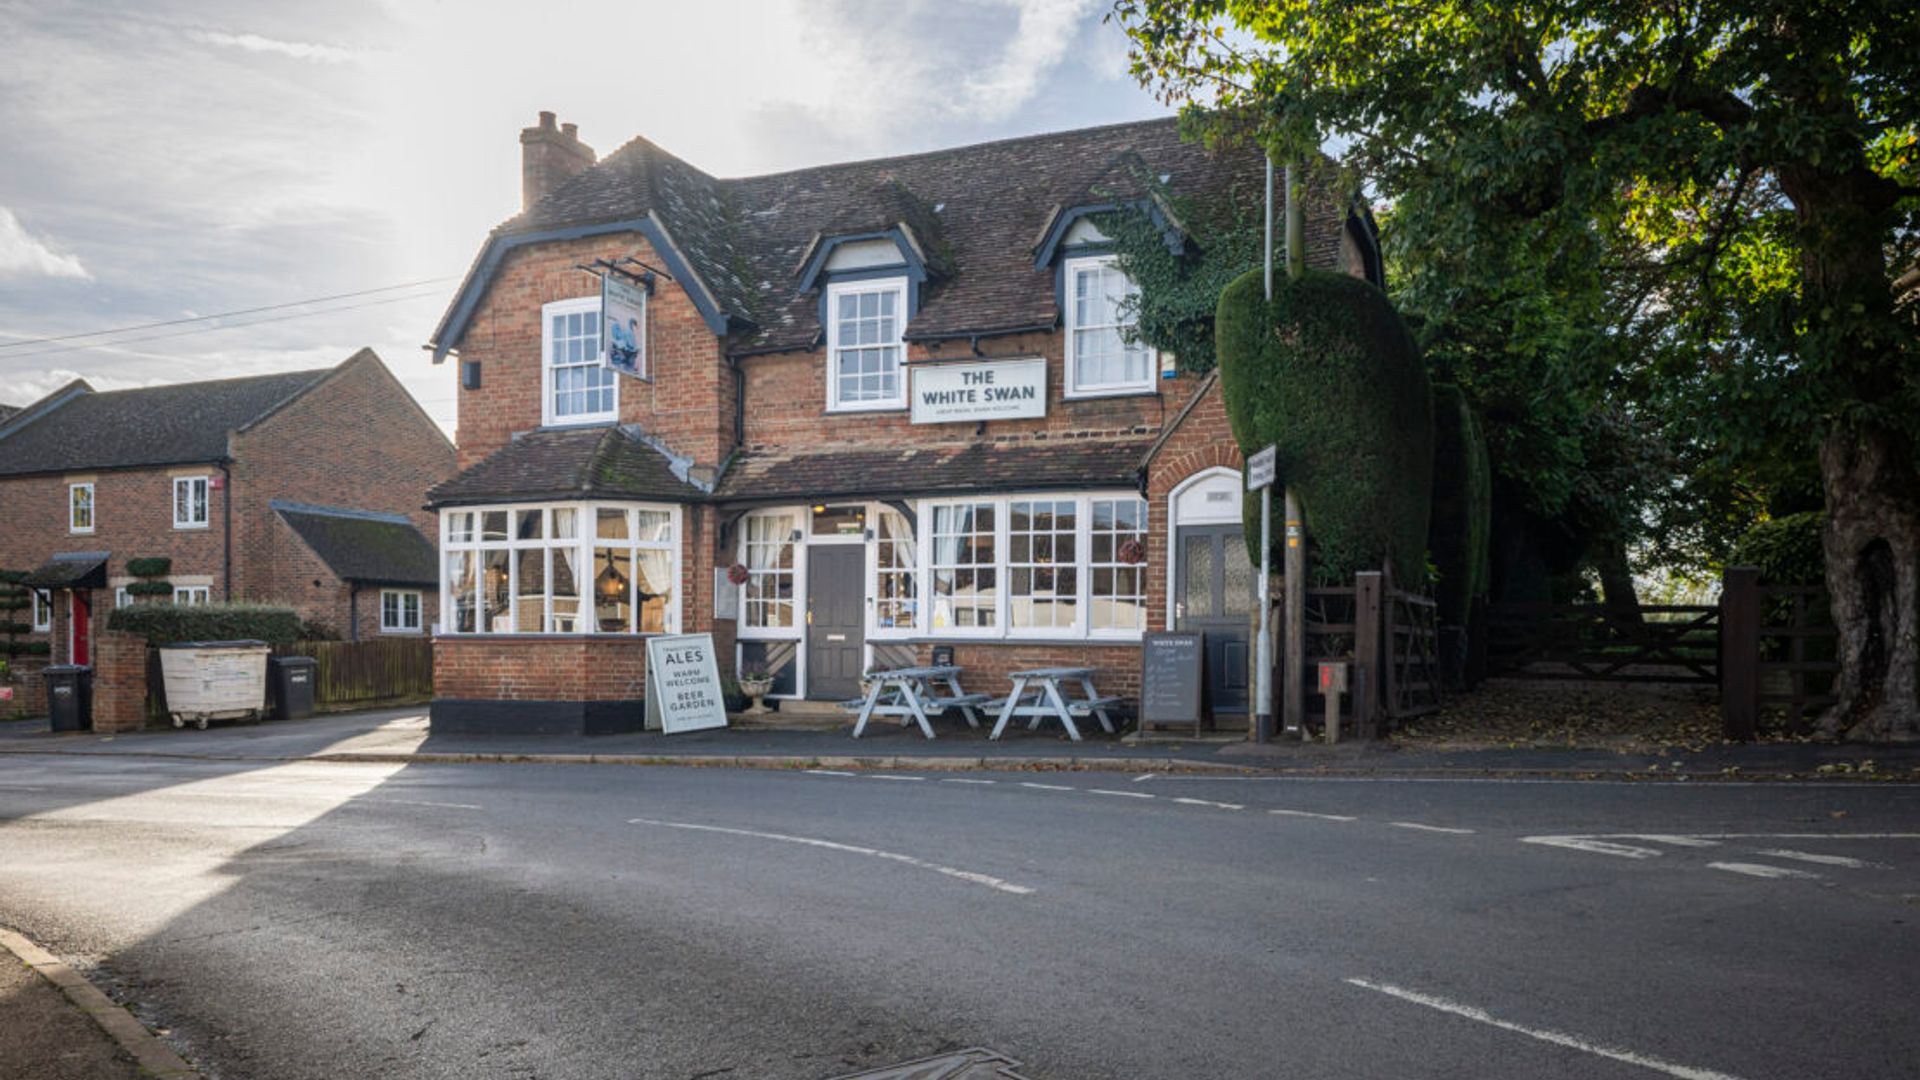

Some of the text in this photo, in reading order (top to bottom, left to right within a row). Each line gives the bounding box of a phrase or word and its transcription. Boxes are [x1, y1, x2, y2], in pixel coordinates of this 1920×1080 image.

[961, 371, 994, 385] THE
[922, 386, 1034, 405] WHITE SWAN
[666, 651, 704, 665] ALES
[673, 669, 700, 678] WARM
[666, 676, 710, 687] WELCOME
[677, 690, 704, 701] BEER
[670, 700, 715, 711] GARDEN
